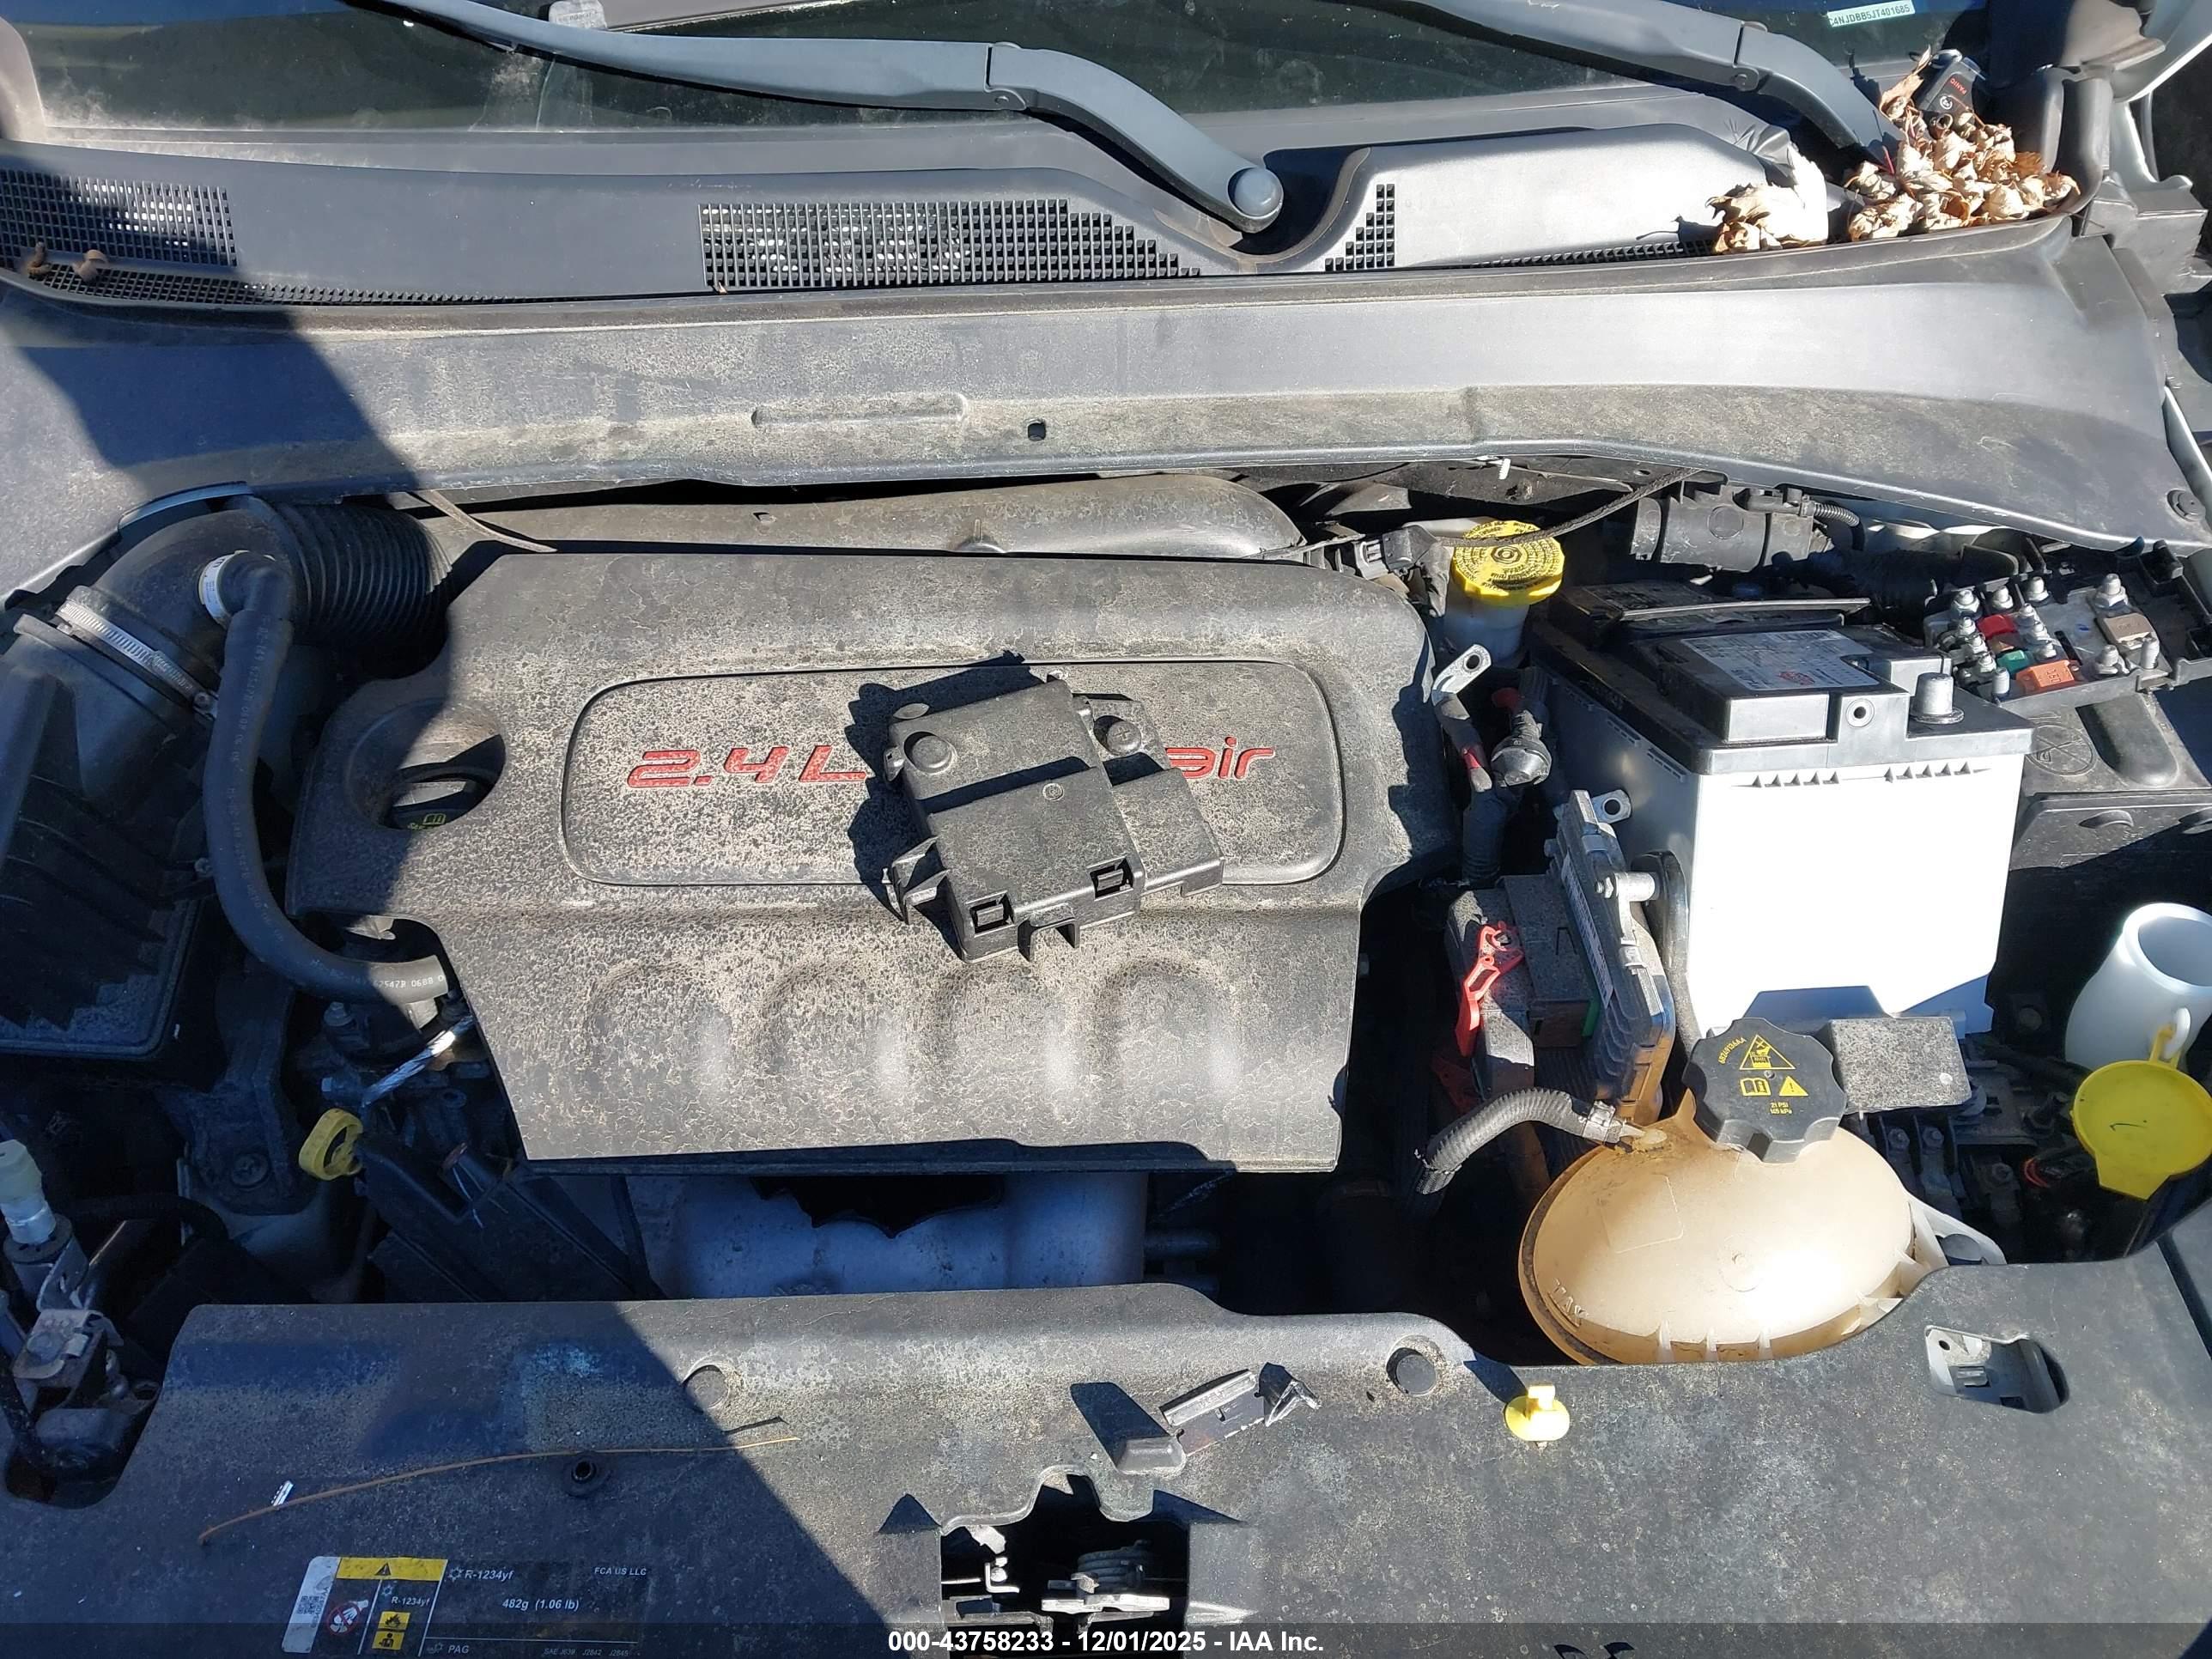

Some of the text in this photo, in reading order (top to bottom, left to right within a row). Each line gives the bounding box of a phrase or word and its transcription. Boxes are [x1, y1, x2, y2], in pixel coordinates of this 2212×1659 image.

[465, 1570, 514, 1581] R-1234yf
[594, 1567, 647, 1576] FCA US LLC
[391, 1595, 430, 1607] R-1234yf
[502, 1599, 580, 1611] 482g (1.06 lb)
[447, 1645, 470, 1655] PAG
